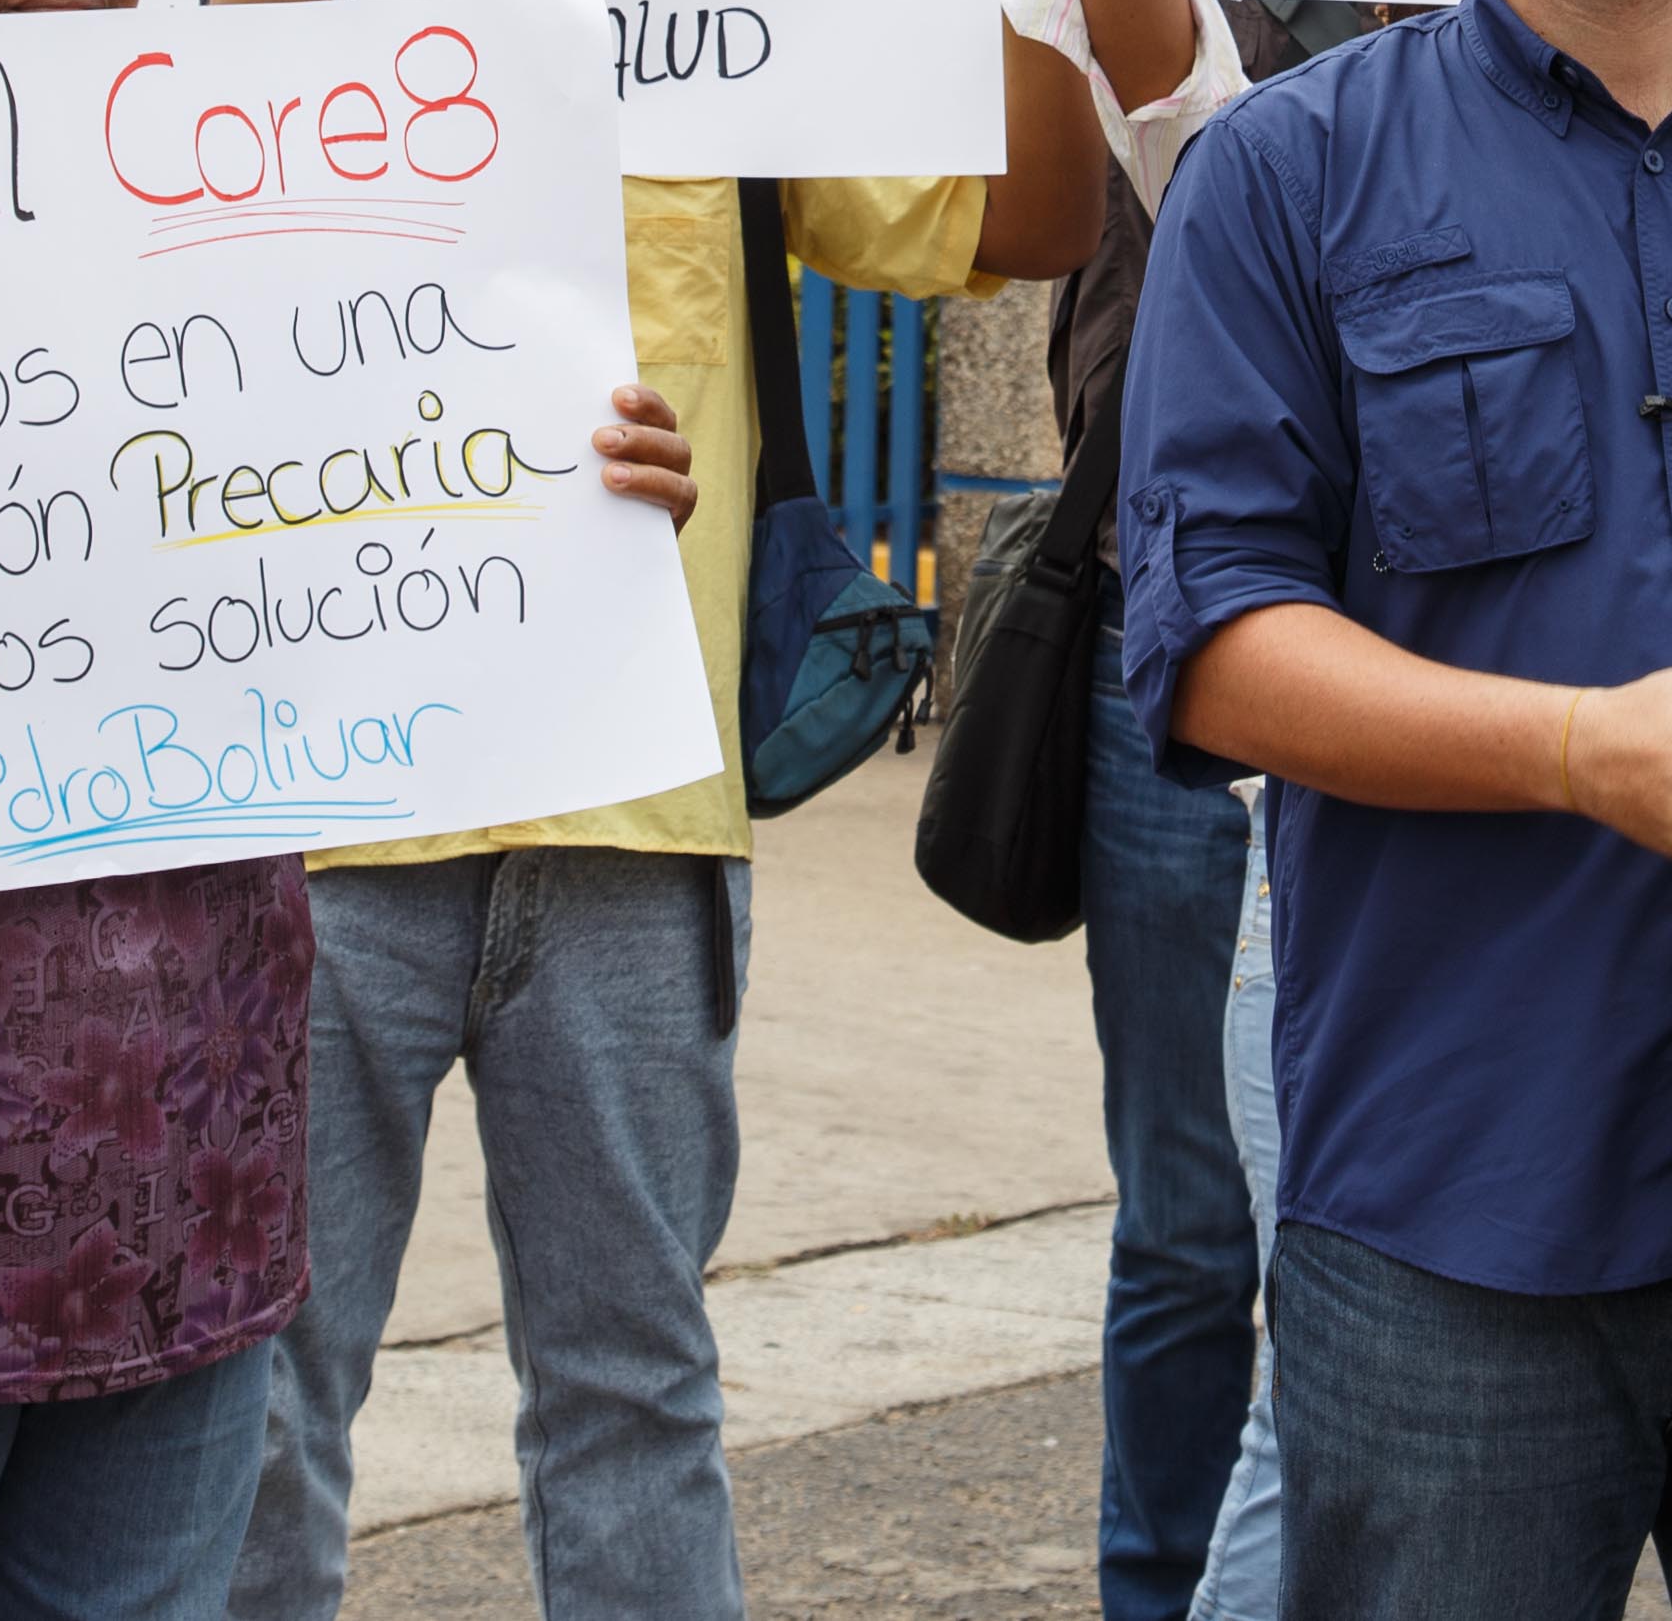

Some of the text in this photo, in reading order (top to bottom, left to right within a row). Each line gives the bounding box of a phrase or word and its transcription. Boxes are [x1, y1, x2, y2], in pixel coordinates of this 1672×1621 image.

[105, 25, 498, 206] Core8
[121, 314, 243, 409] en
[293, 283, 516, 377] una
[110, 391, 578, 538] Precaria
[149, 527, 525, 671] solución
